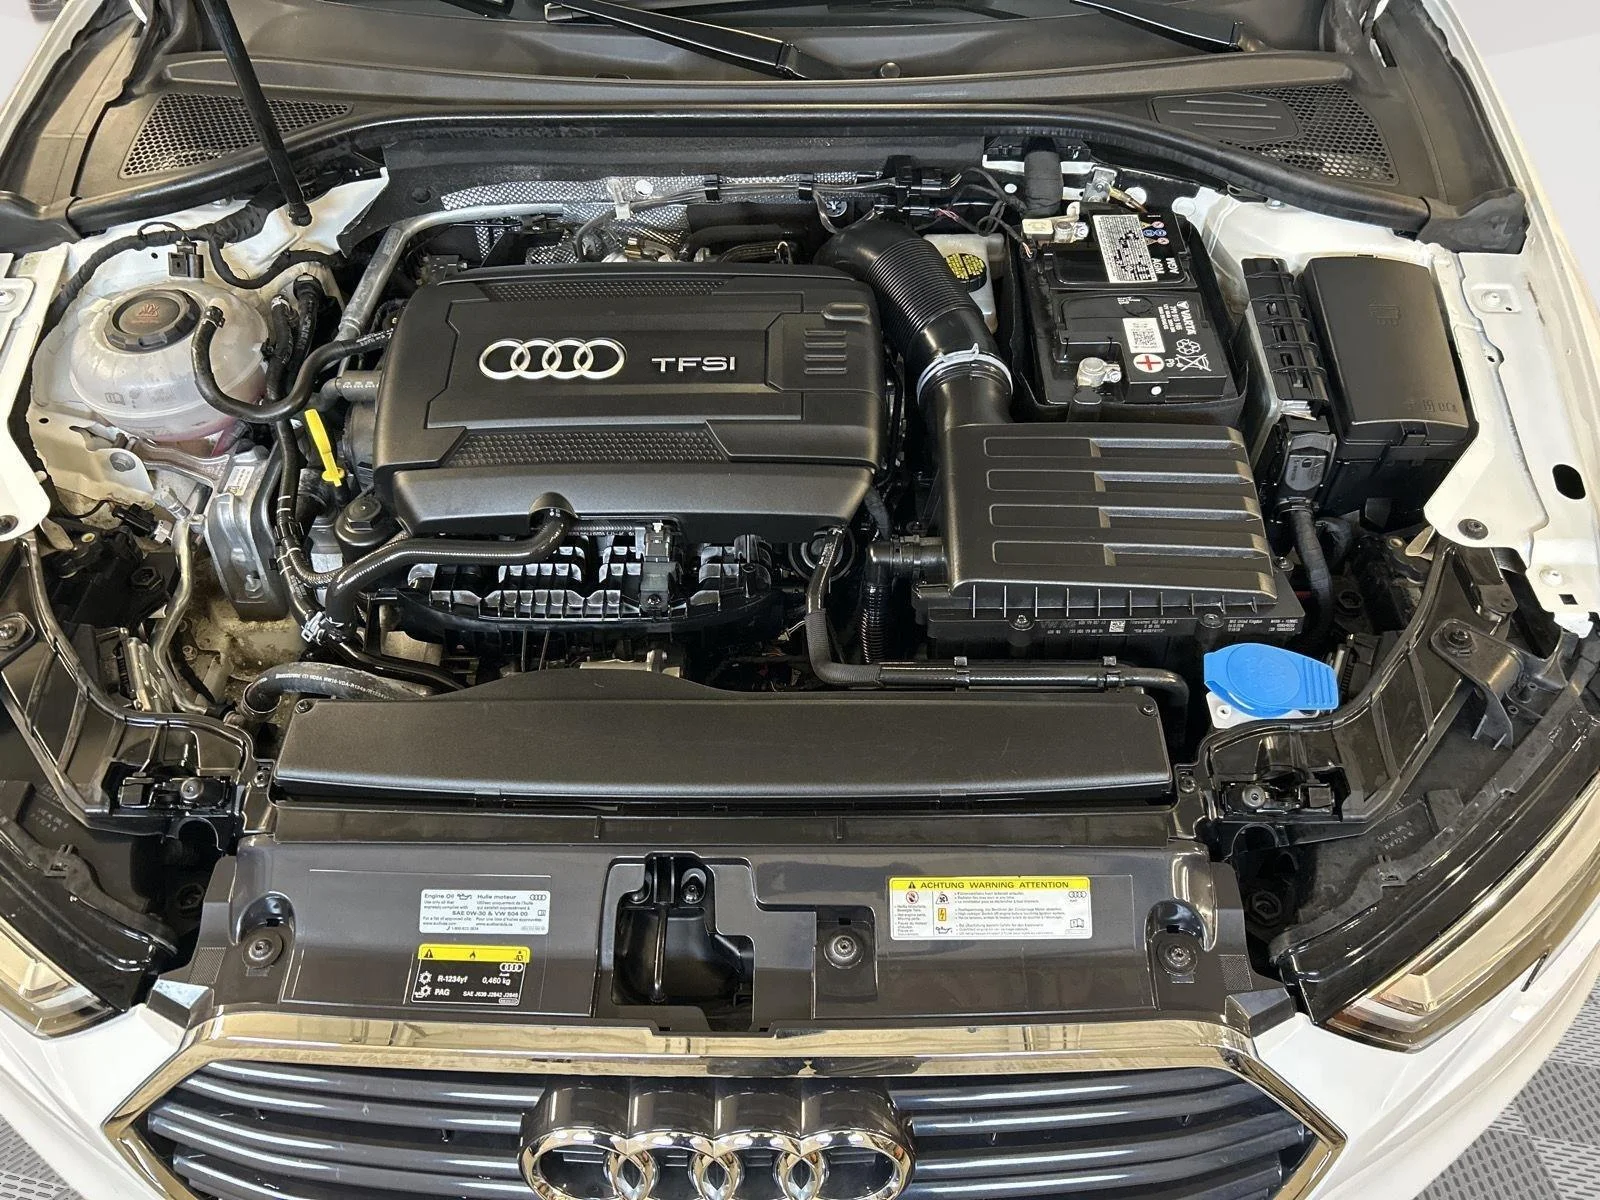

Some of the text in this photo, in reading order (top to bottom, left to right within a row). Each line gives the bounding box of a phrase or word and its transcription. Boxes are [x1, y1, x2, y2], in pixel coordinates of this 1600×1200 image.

[1151, 257, 1165, 274] AGM
[1181, 309, 1197, 335] VARTA
[651, 356, 735, 372] TFSI
[920, 881, 1069, 889] ACHTUNG WARNING ATTENTION
[437, 975, 468, 984] R-1234yf
[502, 978, 511, 986] kg
[434, 988, 450, 996] PAG
